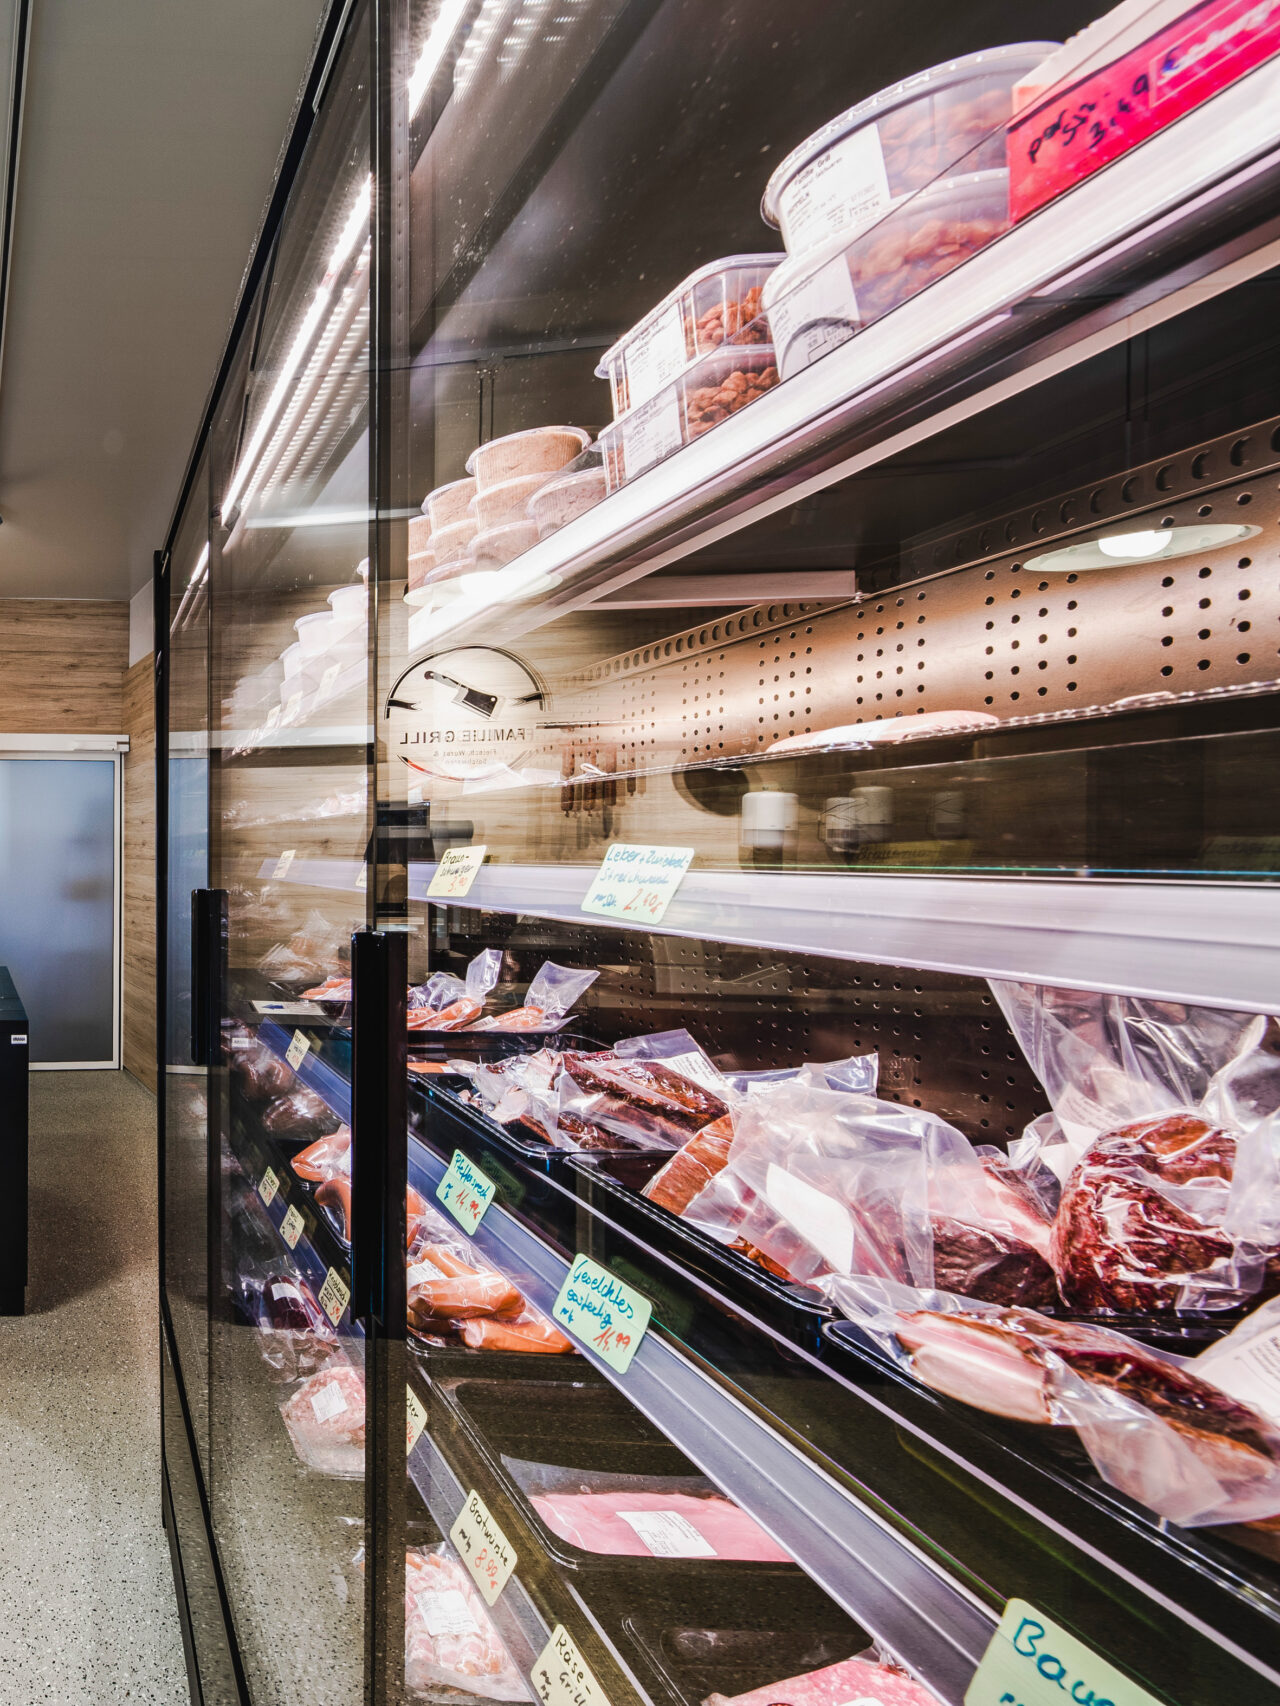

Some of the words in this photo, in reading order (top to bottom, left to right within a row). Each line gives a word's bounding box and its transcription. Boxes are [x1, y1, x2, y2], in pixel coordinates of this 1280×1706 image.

[573, 1259, 634, 1319] Geselchtes
[469, 1497, 508, 1567] Bratwürste
[1013, 1617, 1116, 1706] Bau
